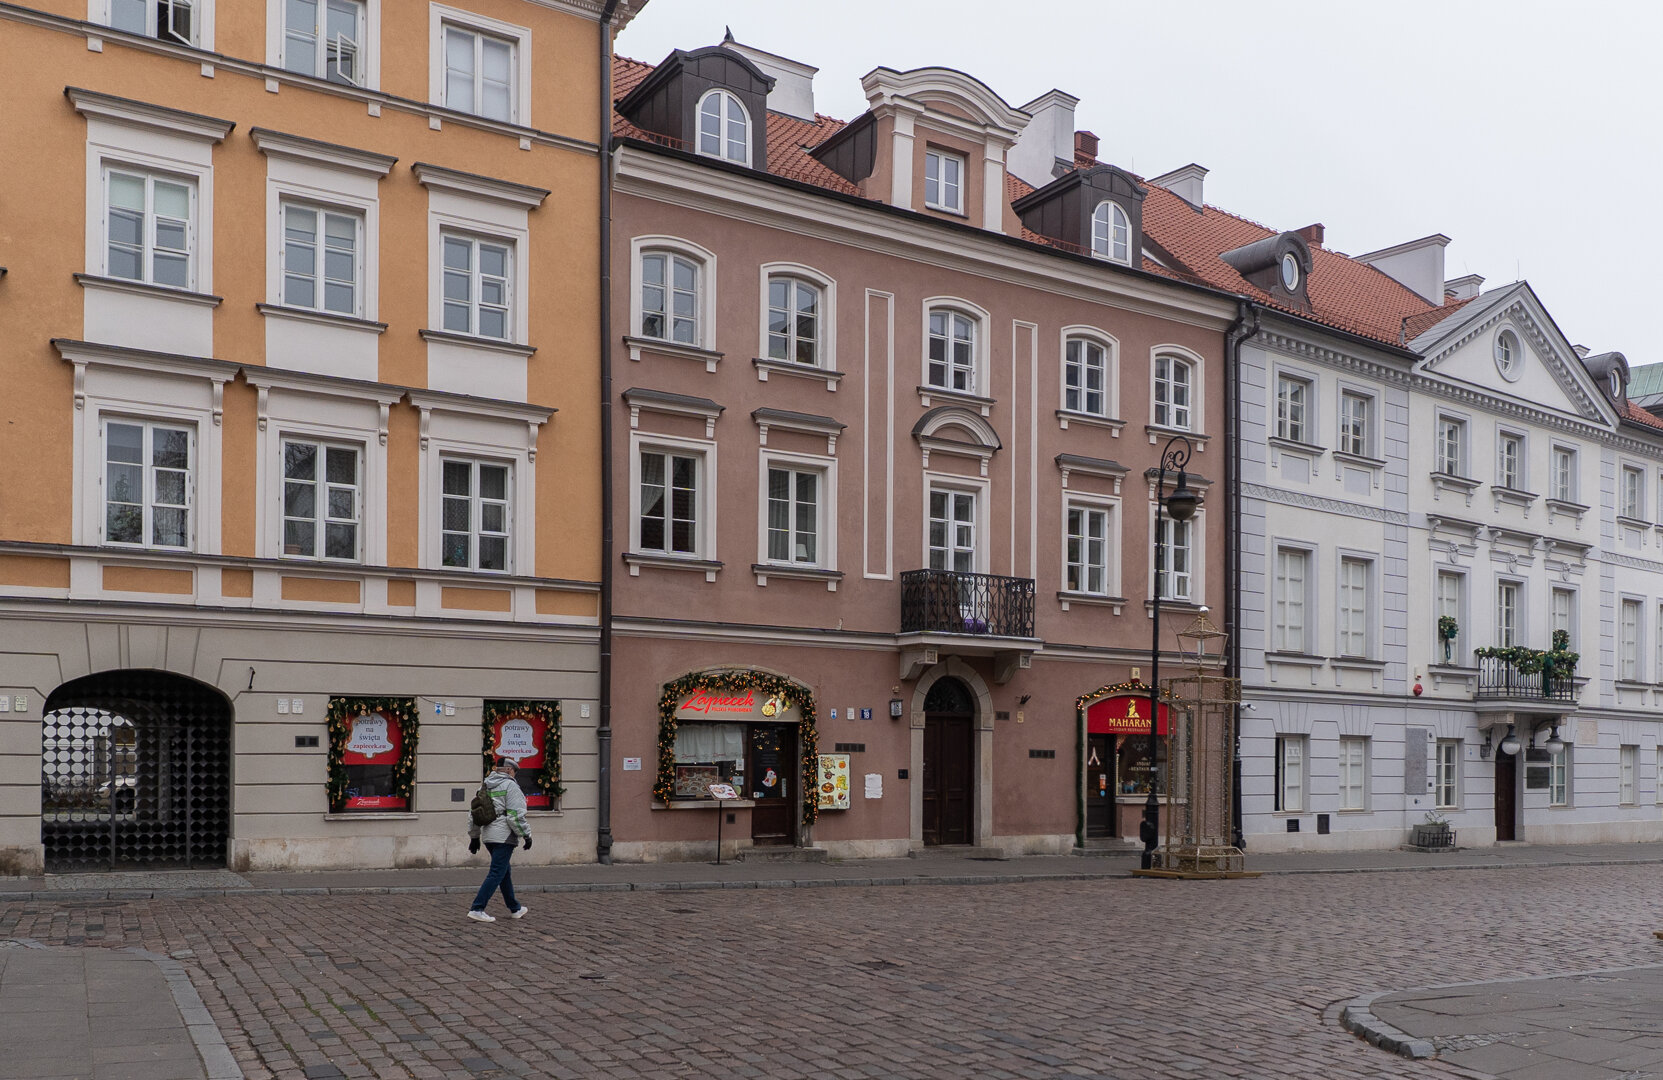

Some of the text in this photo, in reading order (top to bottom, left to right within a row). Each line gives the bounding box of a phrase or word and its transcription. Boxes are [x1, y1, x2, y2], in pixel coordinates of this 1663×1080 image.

[681, 688, 755, 714] Zapiecek
[356, 719, 384, 727] potrawy
[1109, 718, 1152, 728] MAHARAN
[504, 724, 530, 732] potrawy
[507, 739, 527, 747] święta
